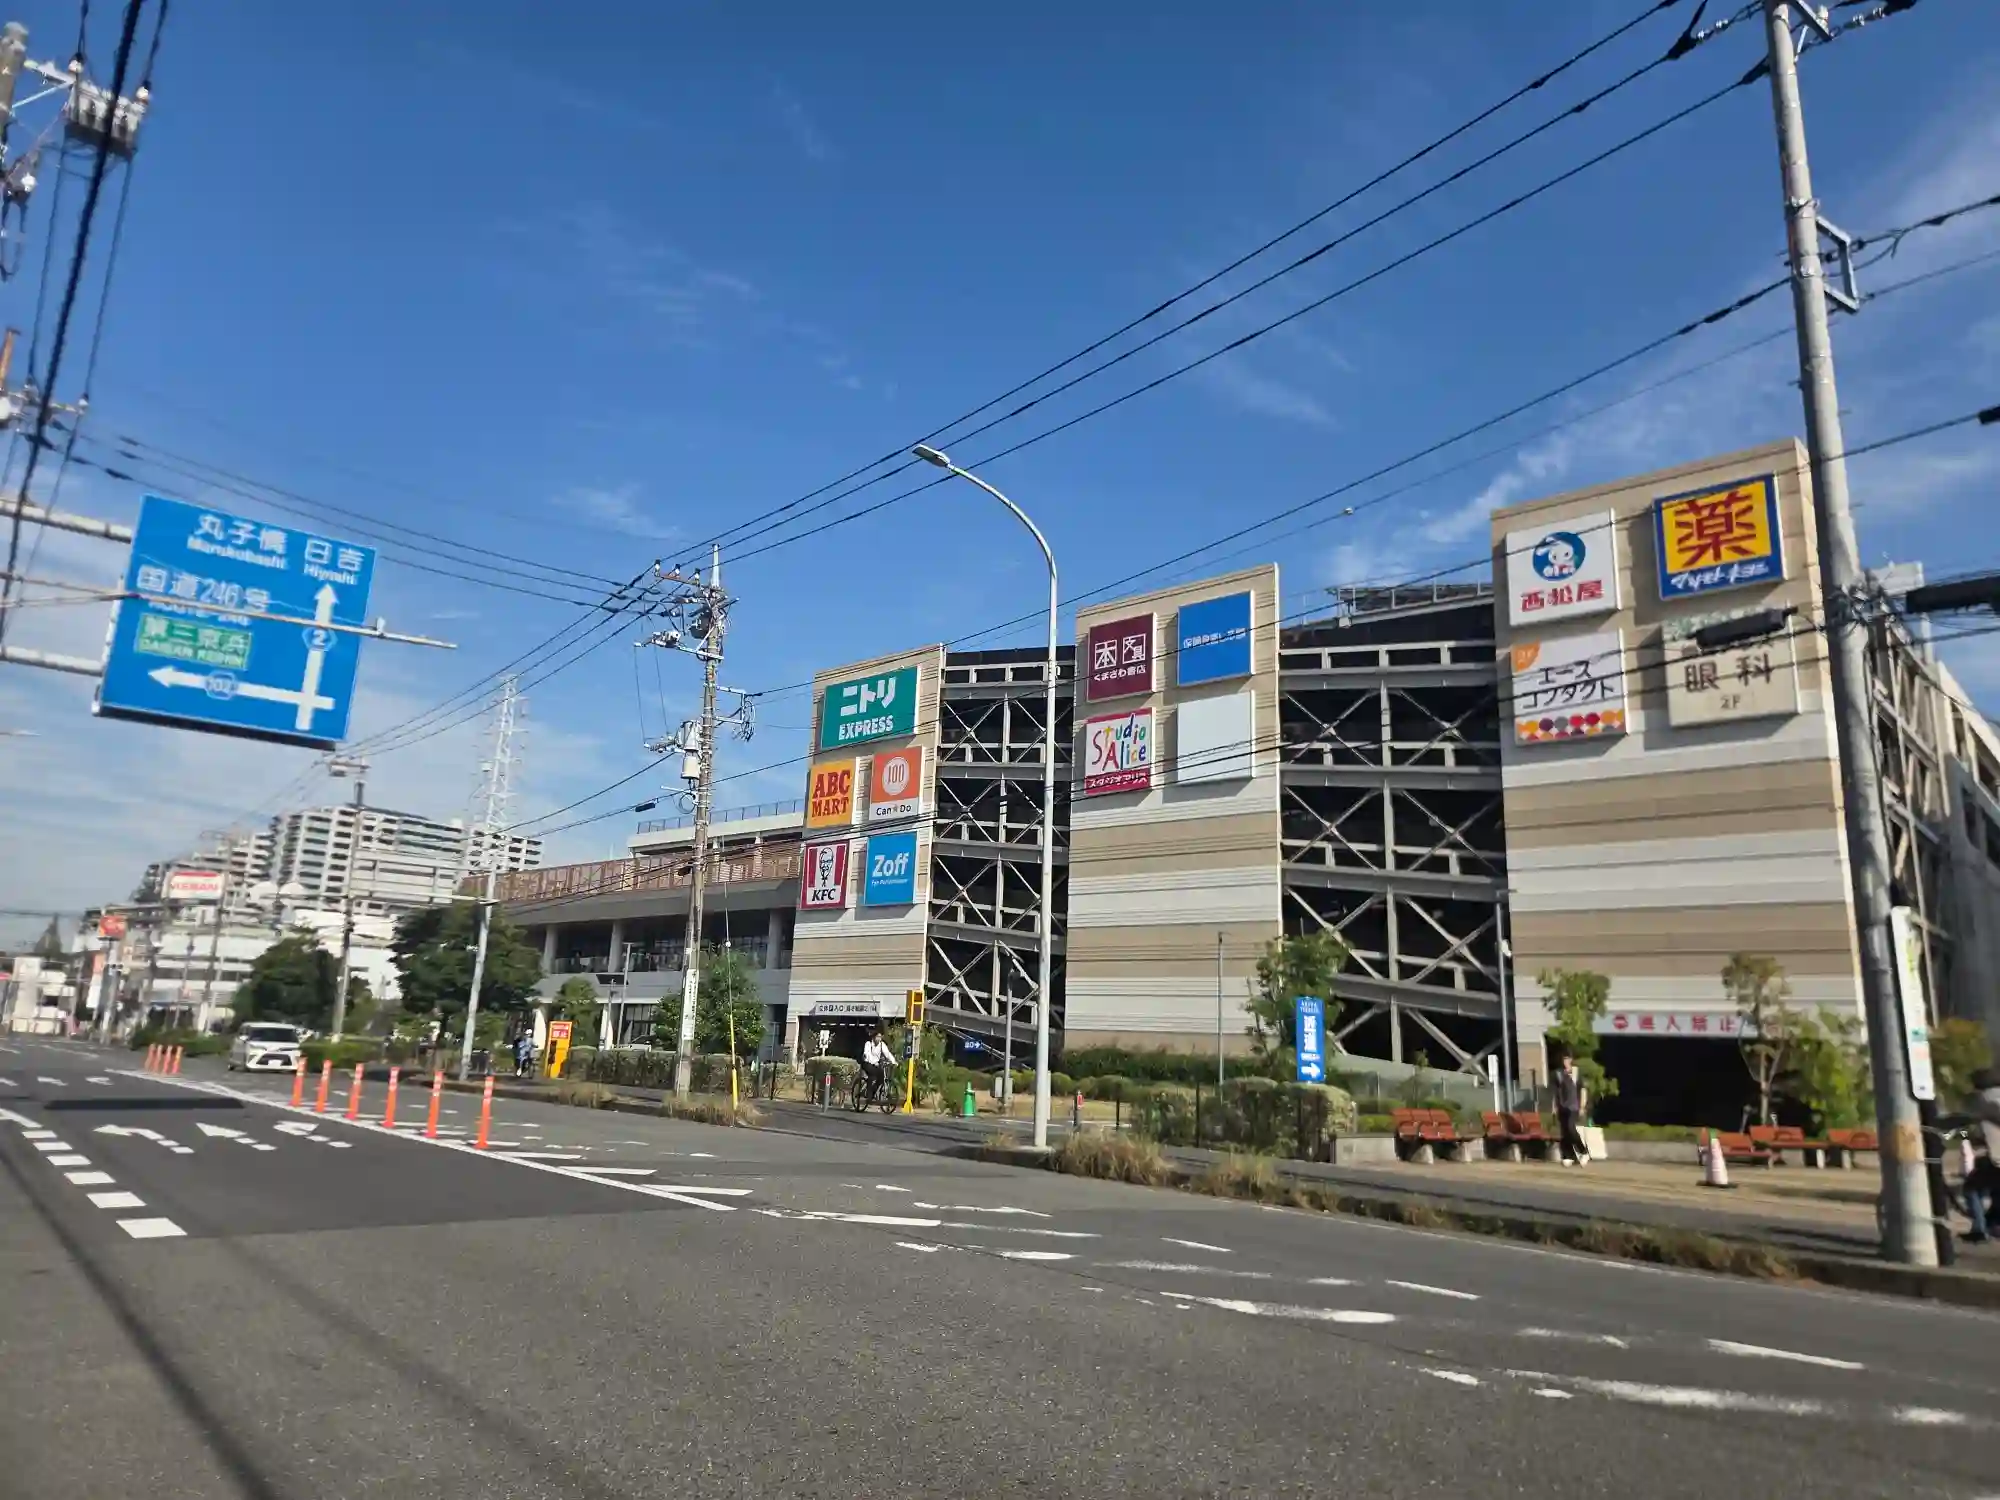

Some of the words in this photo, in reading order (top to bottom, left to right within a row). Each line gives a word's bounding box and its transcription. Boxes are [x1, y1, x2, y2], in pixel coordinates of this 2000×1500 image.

[194, 513, 288, 555] 丸子橋
[1674, 490, 1757, 567] 薬
[304, 537, 365, 572] 日吉
[136, 565, 270, 613] 国道246号
[1520, 579, 1605, 613] 西松屋
[311, 632, 325, 645] 2
[1093, 665, 1147, 681] くまざわ書店
[1538, 660, 1592, 685] エース
[1684, 652, 1771, 693] 眼科
[840, 676, 897, 717] ニトリ
[1721, 694, 1740, 709] 2F
[838, 714, 894, 741] EXPRESS
[812, 769, 851, 800] ABC
[887, 764, 904, 784] 100
[811, 797, 849, 818] MART
[876, 806, 892, 816] Can
[899, 804, 912, 813] Do
[872, 852, 909, 877] Zoff
[811, 888, 836, 901] KFC
[1639, 1013, 1738, 1033] 進入禁止
